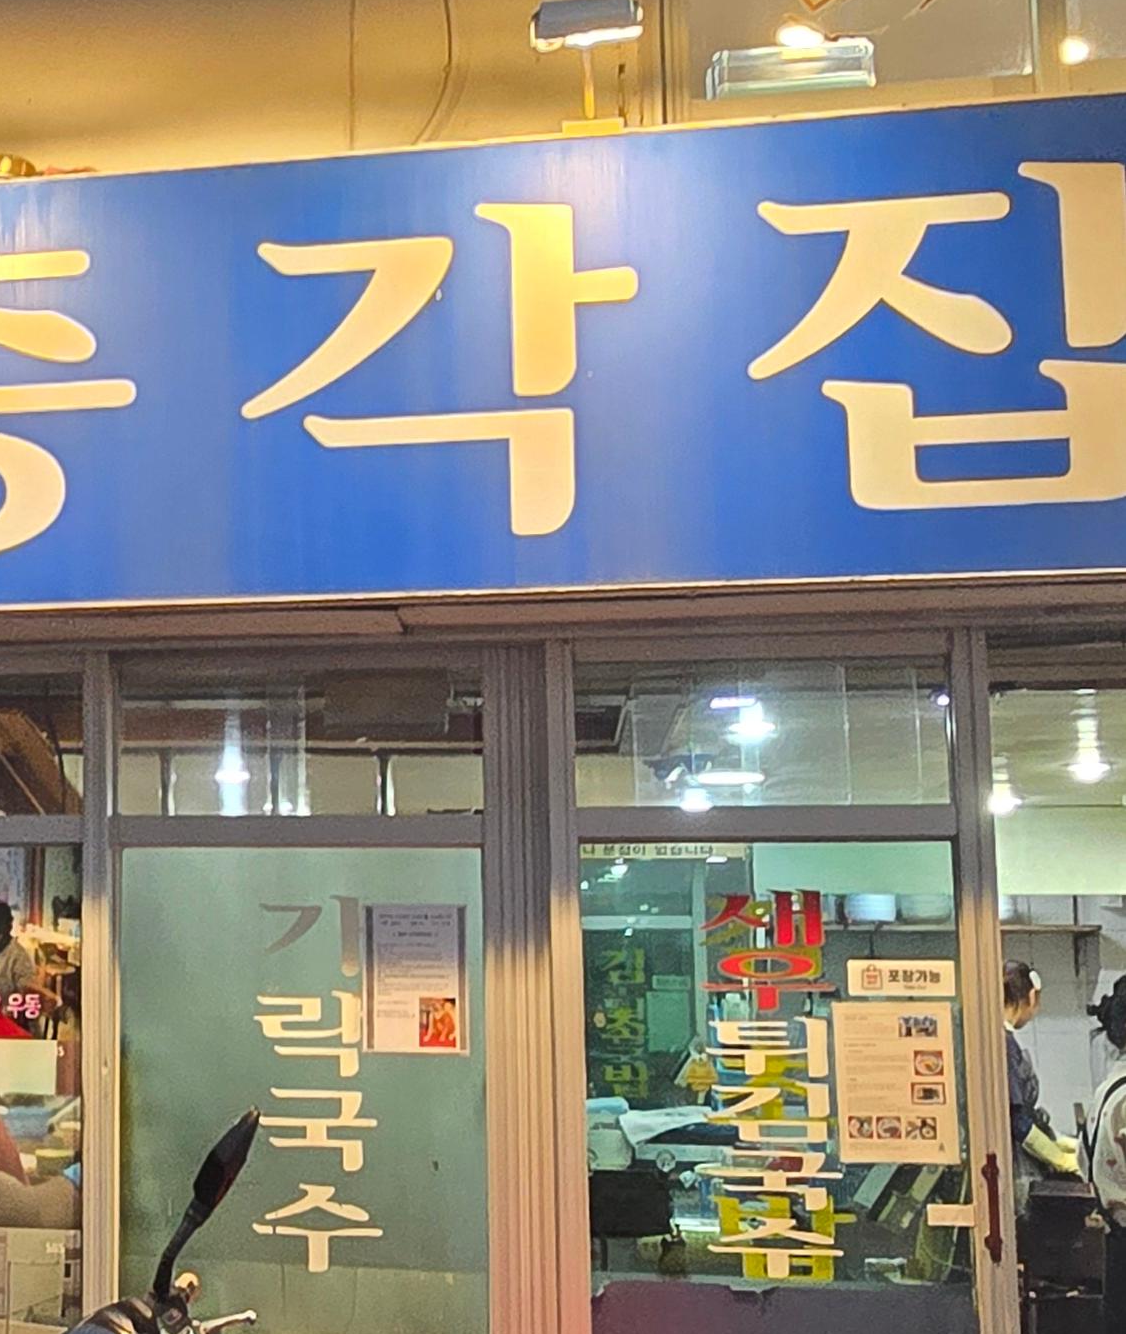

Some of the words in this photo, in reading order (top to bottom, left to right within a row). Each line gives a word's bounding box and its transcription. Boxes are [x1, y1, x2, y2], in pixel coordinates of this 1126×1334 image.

[888, 969, 941, 984] 포장가능
[7, 993, 42, 1019] 우동
[701, 889, 844, 1278] 새우튀김국수
